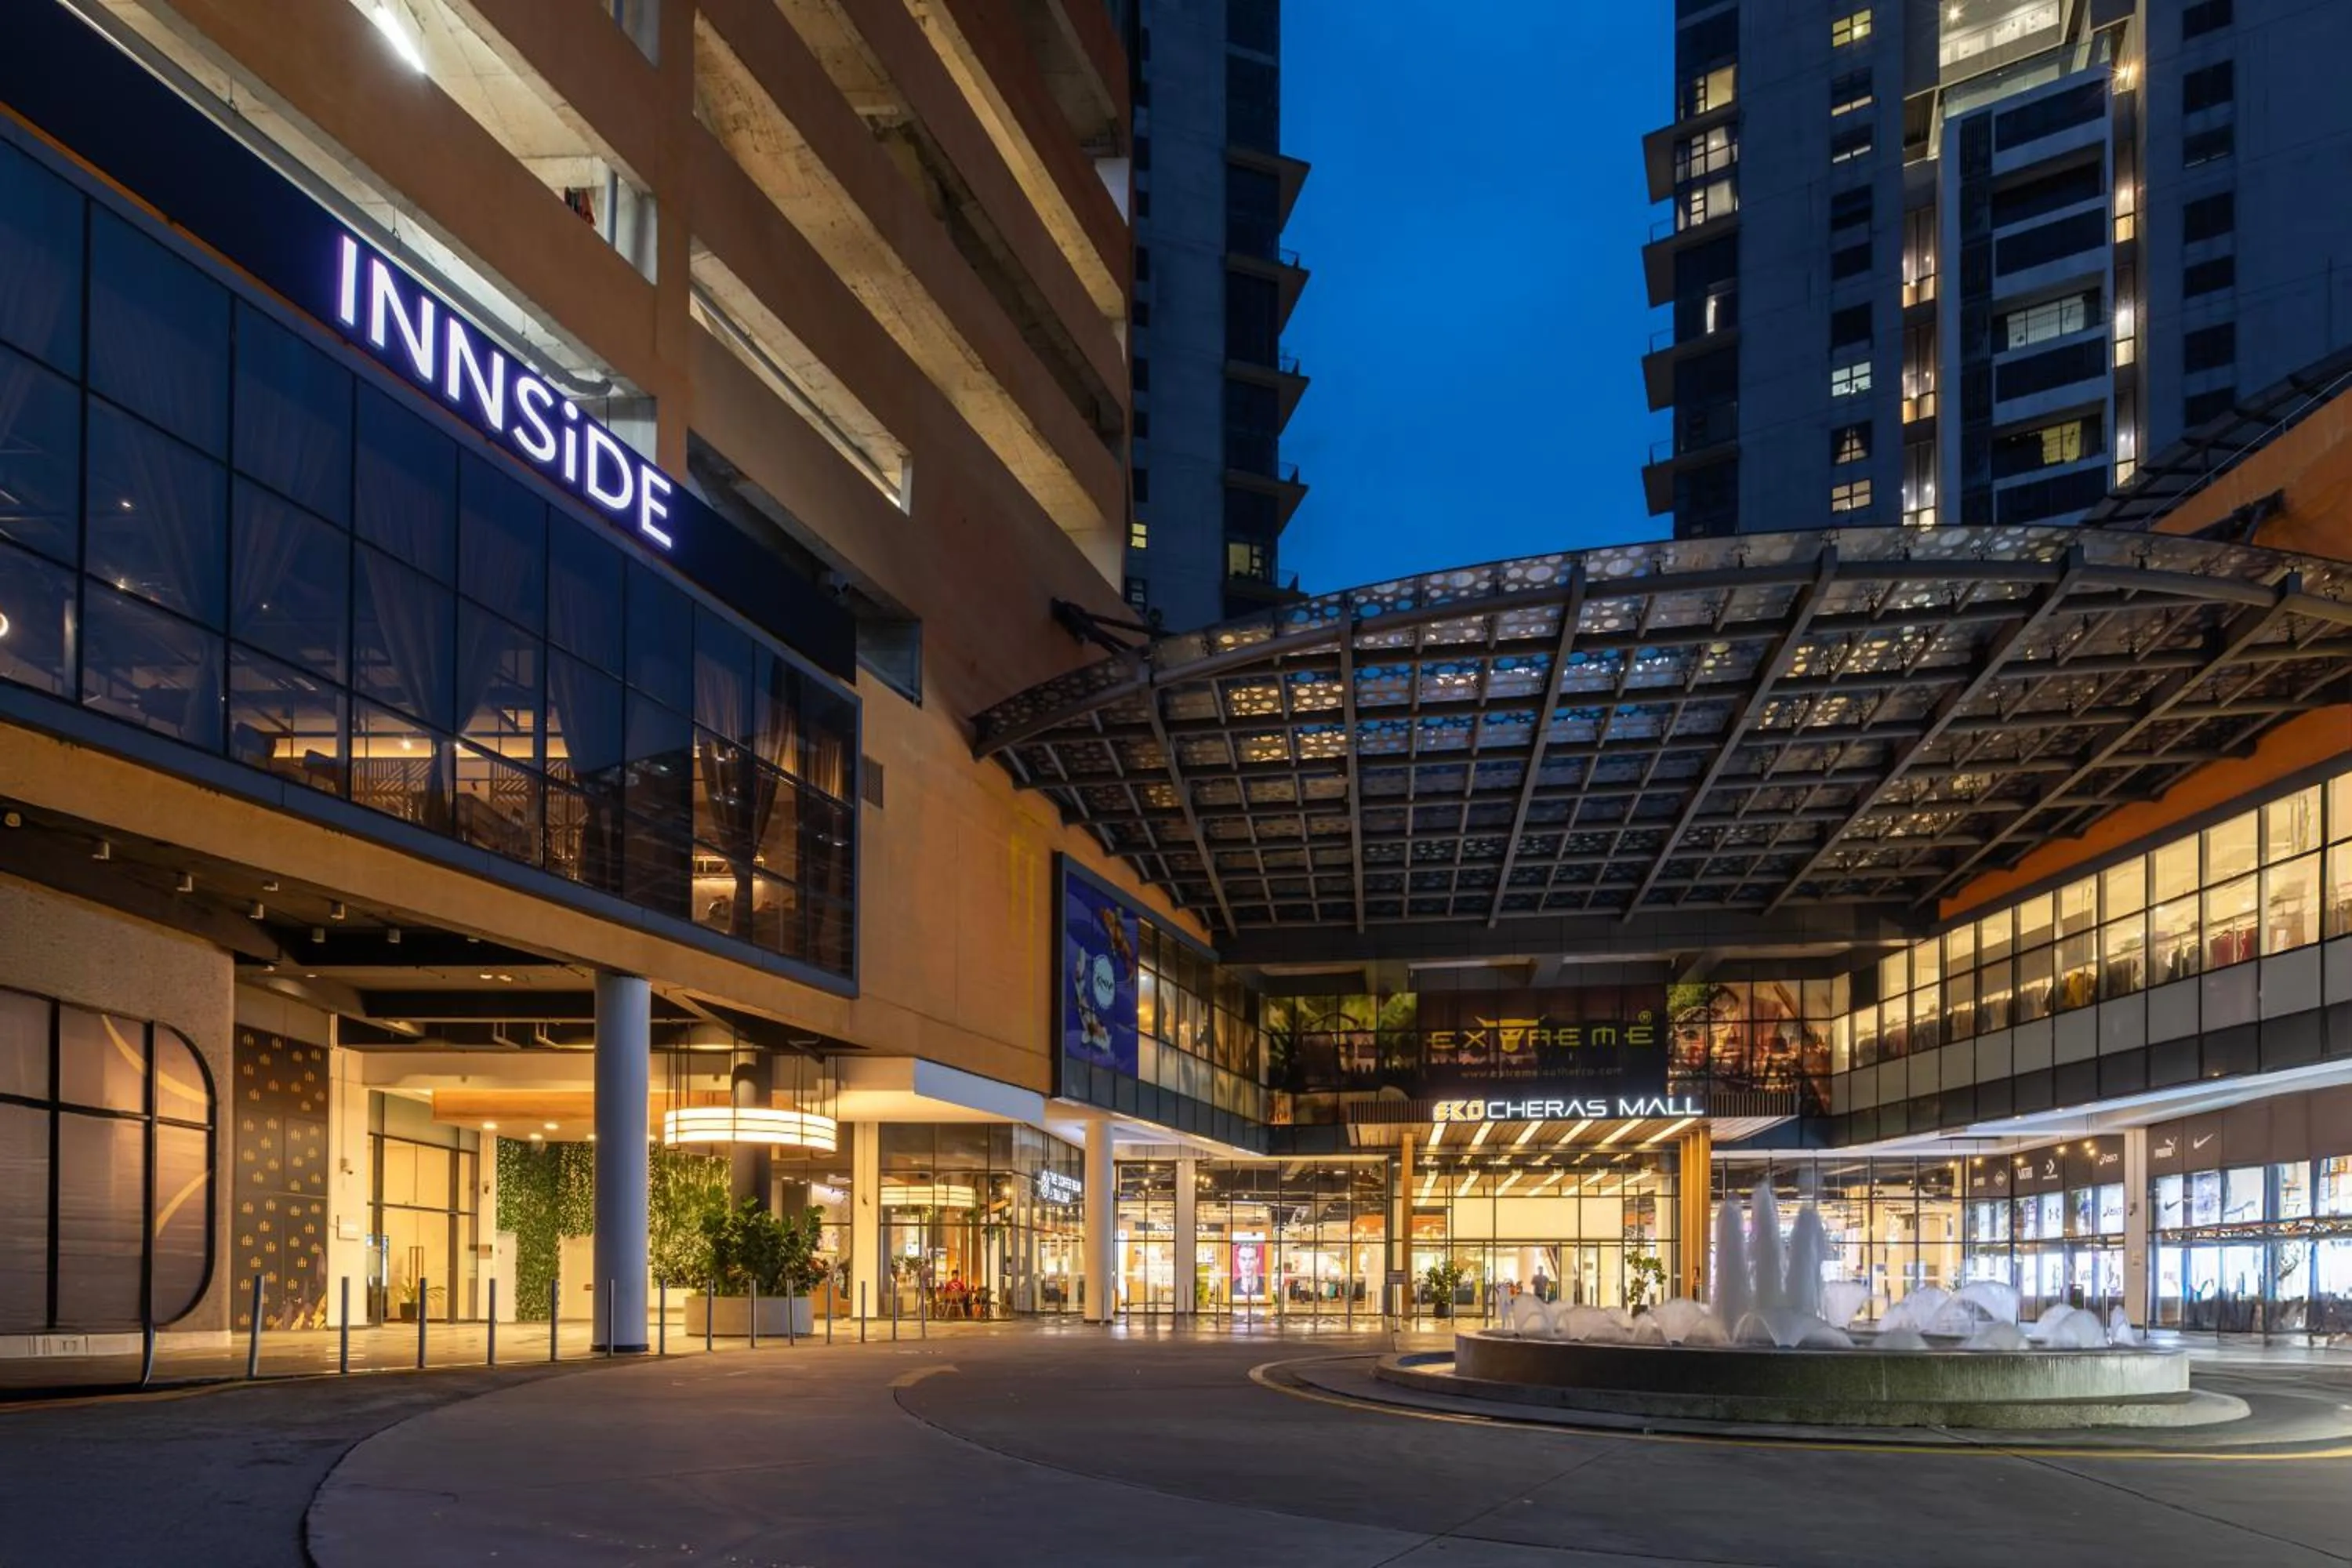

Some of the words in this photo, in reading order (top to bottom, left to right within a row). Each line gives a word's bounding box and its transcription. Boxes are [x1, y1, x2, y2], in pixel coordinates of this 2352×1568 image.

[339, 234, 673, 549] INNSiDE
[1486, 1098, 1607, 1119] CHERAS
[1619, 1097, 1704, 1116] MALL
